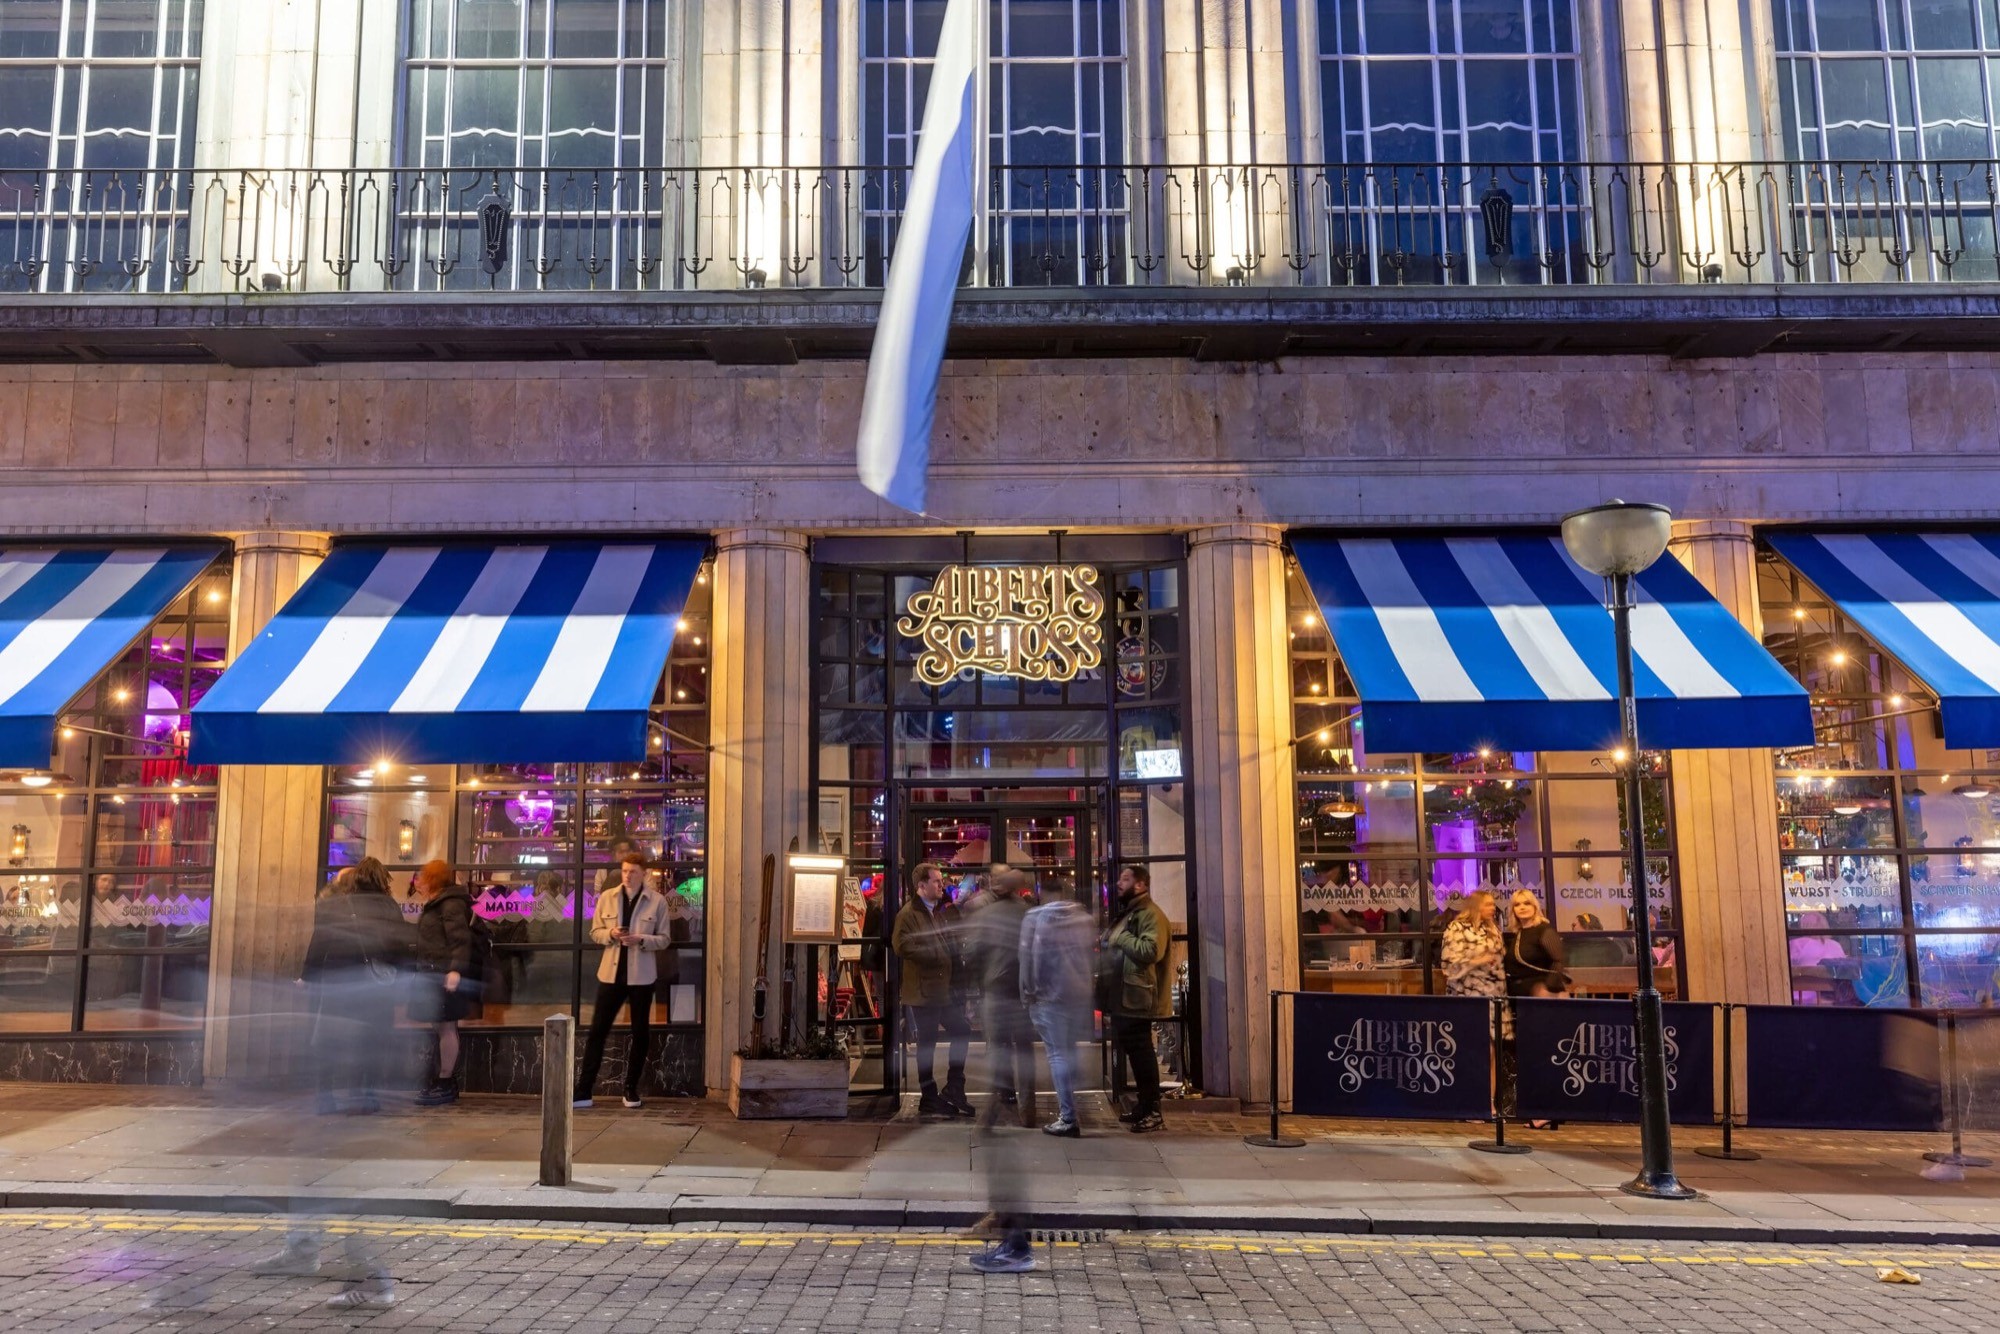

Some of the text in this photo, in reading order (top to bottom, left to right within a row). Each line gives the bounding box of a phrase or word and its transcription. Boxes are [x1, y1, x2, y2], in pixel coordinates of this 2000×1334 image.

[916, 617, 1102, 686] SCHLOSS
[1303, 888, 1419, 900] BAVARIAN BAKERY
[1429, 888, 1473, 900] FONDU
[1560, 887, 1666, 899] CZECH PILSRS
[1789, 886, 1831, 898] WURST
[1841, 887, 1896, 898] STRUDEL
[121, 904, 190, 917] SCHNAPPS
[485, 900, 545, 912] MARTINIS
[1339, 1054, 1456, 1094] SCHLOSS
